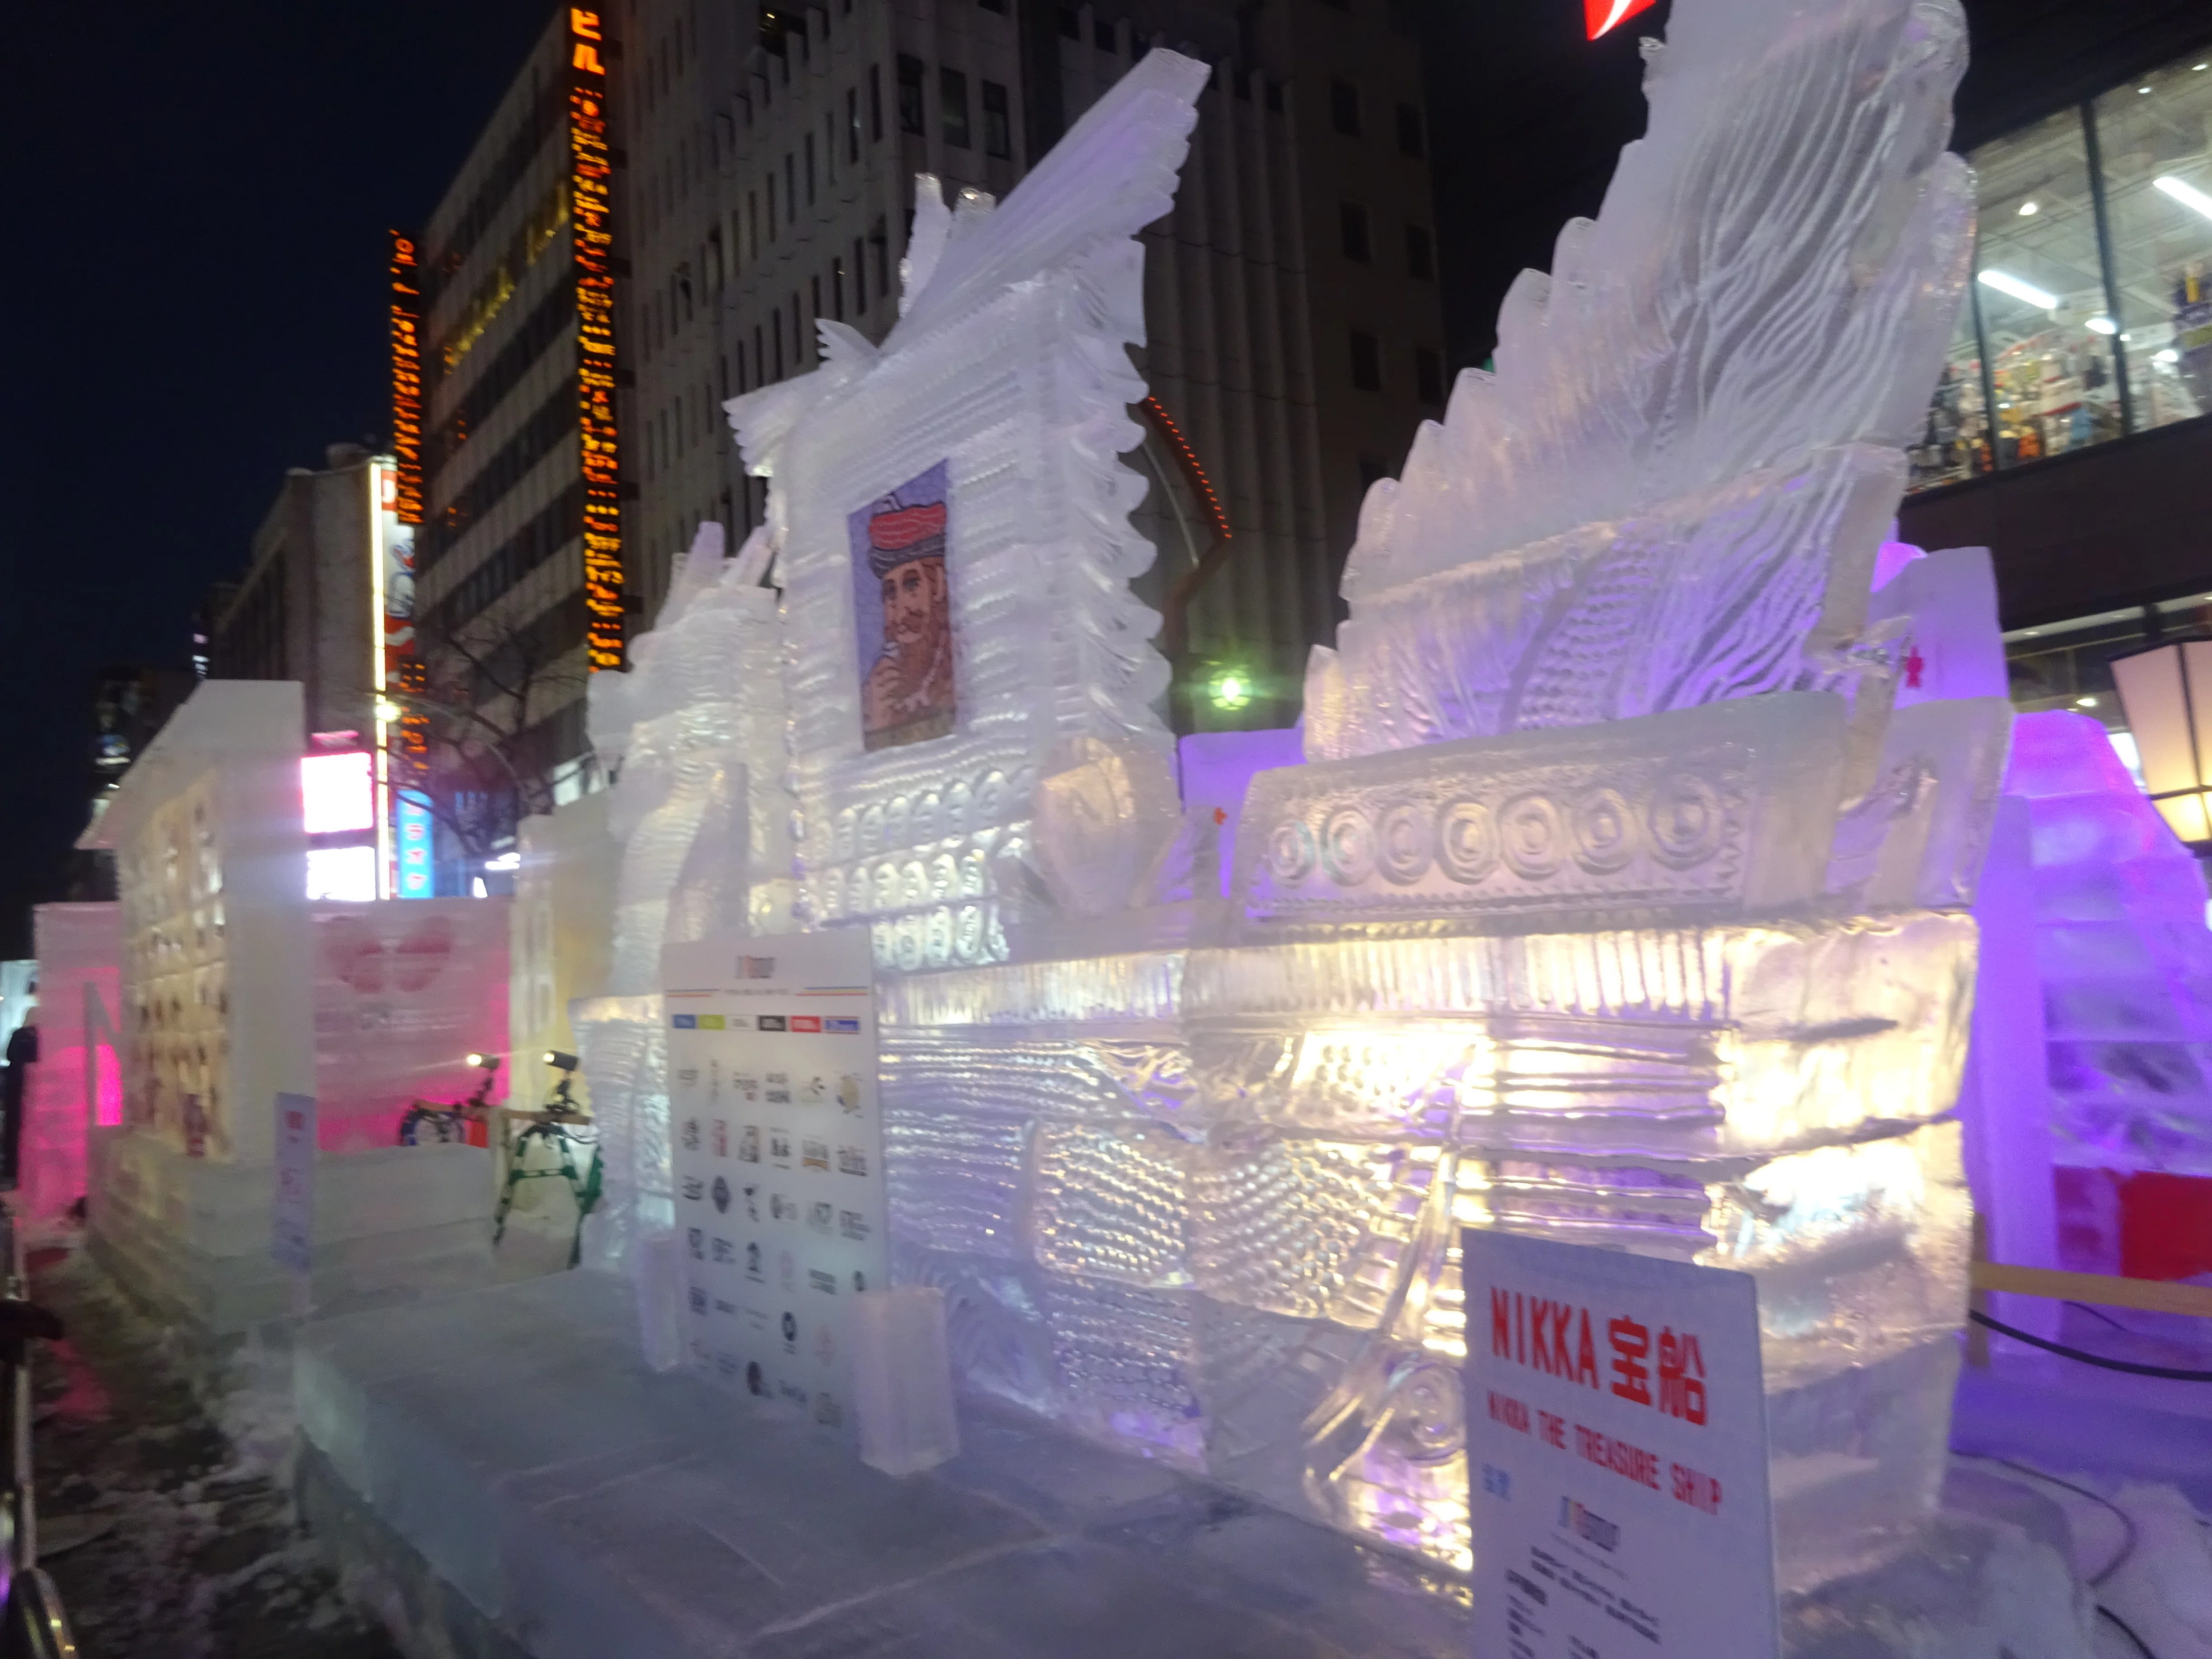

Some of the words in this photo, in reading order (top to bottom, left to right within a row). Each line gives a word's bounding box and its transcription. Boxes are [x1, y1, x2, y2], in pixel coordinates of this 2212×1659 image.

[1491, 1287, 1600, 1390] NIKKA
[1538, 1410, 1566, 1449] THE
[1574, 1423, 1661, 1491] TREASURE
[1669, 1461, 1723, 1516] SHIP
